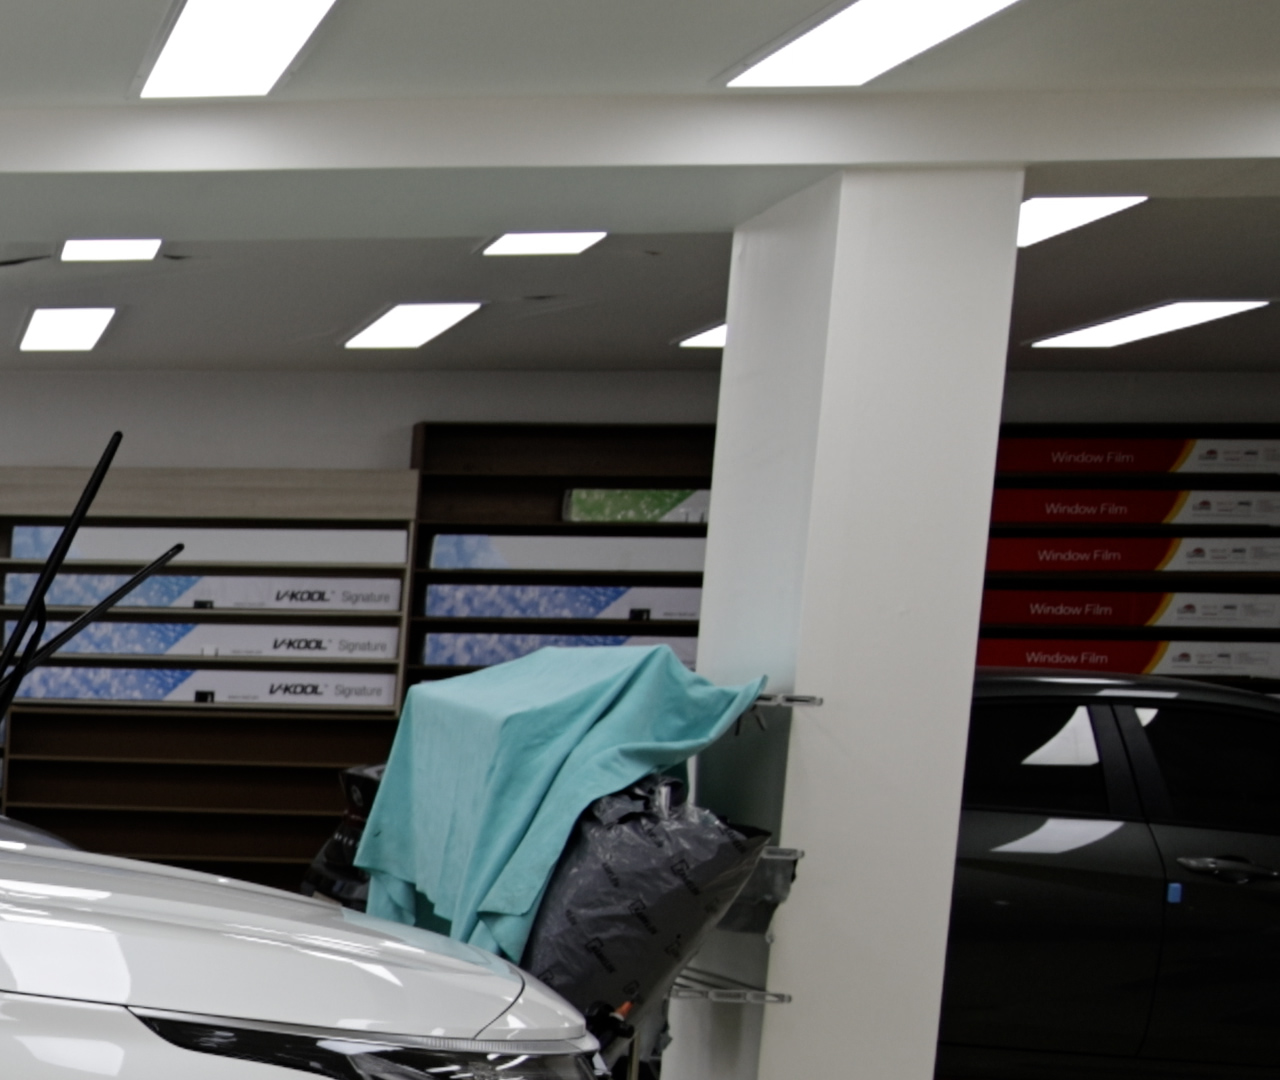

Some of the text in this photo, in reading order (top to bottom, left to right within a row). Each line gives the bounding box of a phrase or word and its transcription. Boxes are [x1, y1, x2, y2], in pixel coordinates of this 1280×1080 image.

[1051, 452, 1134, 463] Window Film
[1045, 503, 1127, 515] Window Film
[1038, 550, 1121, 561] Window Film
[342, 591, 390, 605] Signature
[1030, 603, 1112, 615] Window Film
[338, 640, 387, 653] Signature
[1026, 652, 1108, 664] Window Film
[335, 684, 382, 698] Signature
